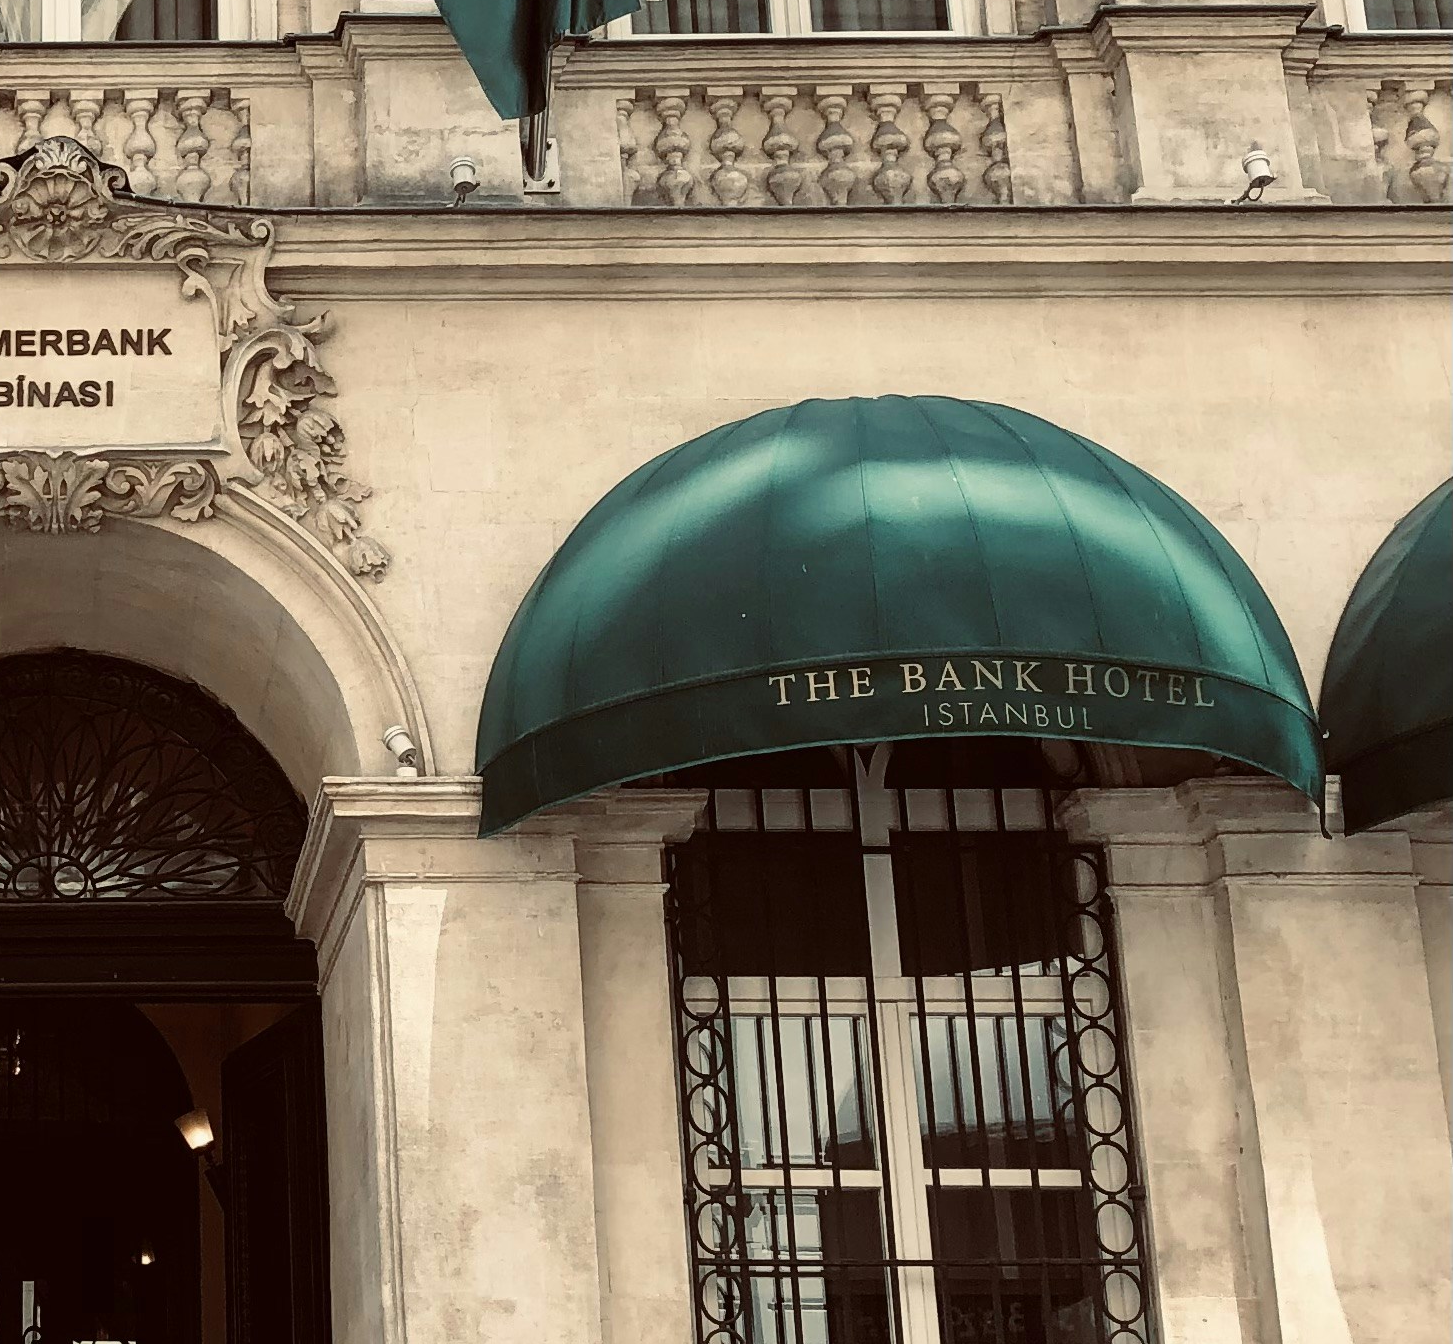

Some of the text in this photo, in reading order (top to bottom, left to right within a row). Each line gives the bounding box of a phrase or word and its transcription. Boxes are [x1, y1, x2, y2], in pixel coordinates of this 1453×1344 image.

[769, 659, 1216, 708] THE BANK HOTEL
[923, 701, 1094, 731] ISTANBUL
